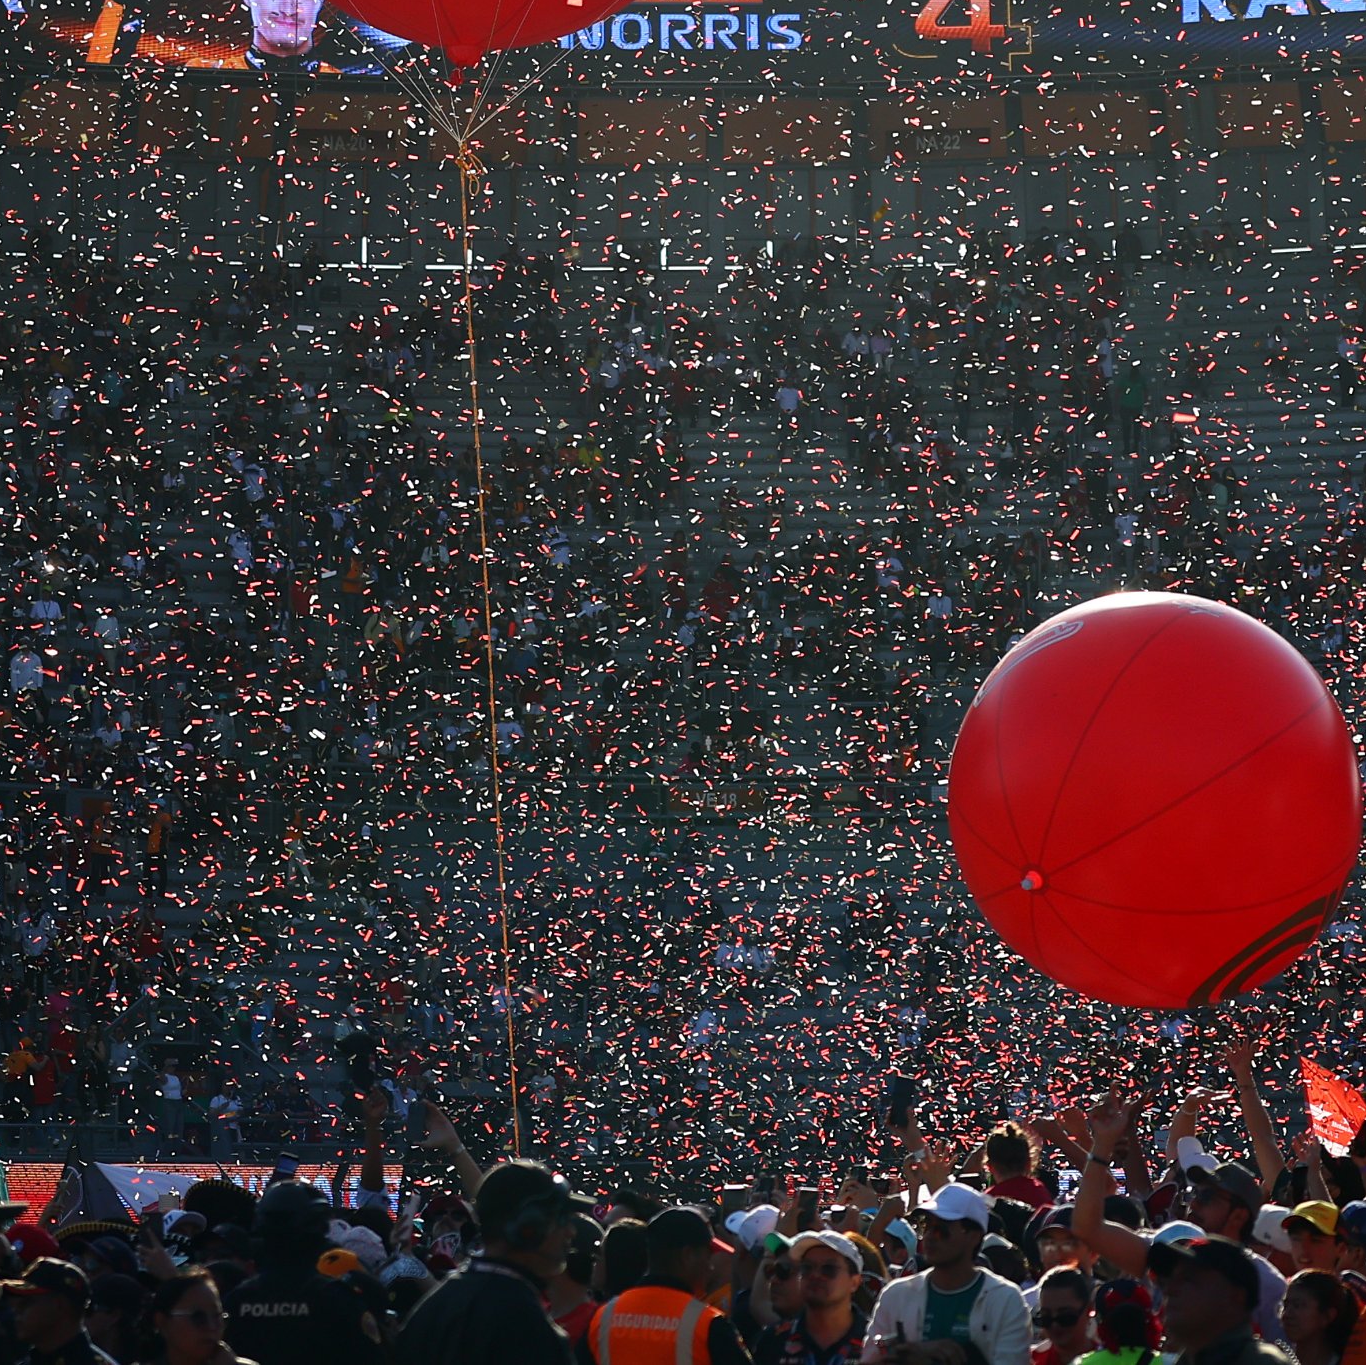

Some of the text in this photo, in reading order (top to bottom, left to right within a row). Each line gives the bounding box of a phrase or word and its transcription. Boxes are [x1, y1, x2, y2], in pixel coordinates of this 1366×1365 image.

[558, 11, 804, 52] NORRIS
[240, 1303, 310, 1316] POLICIA
[611, 1313, 680, 1331] SEGURIDAD
